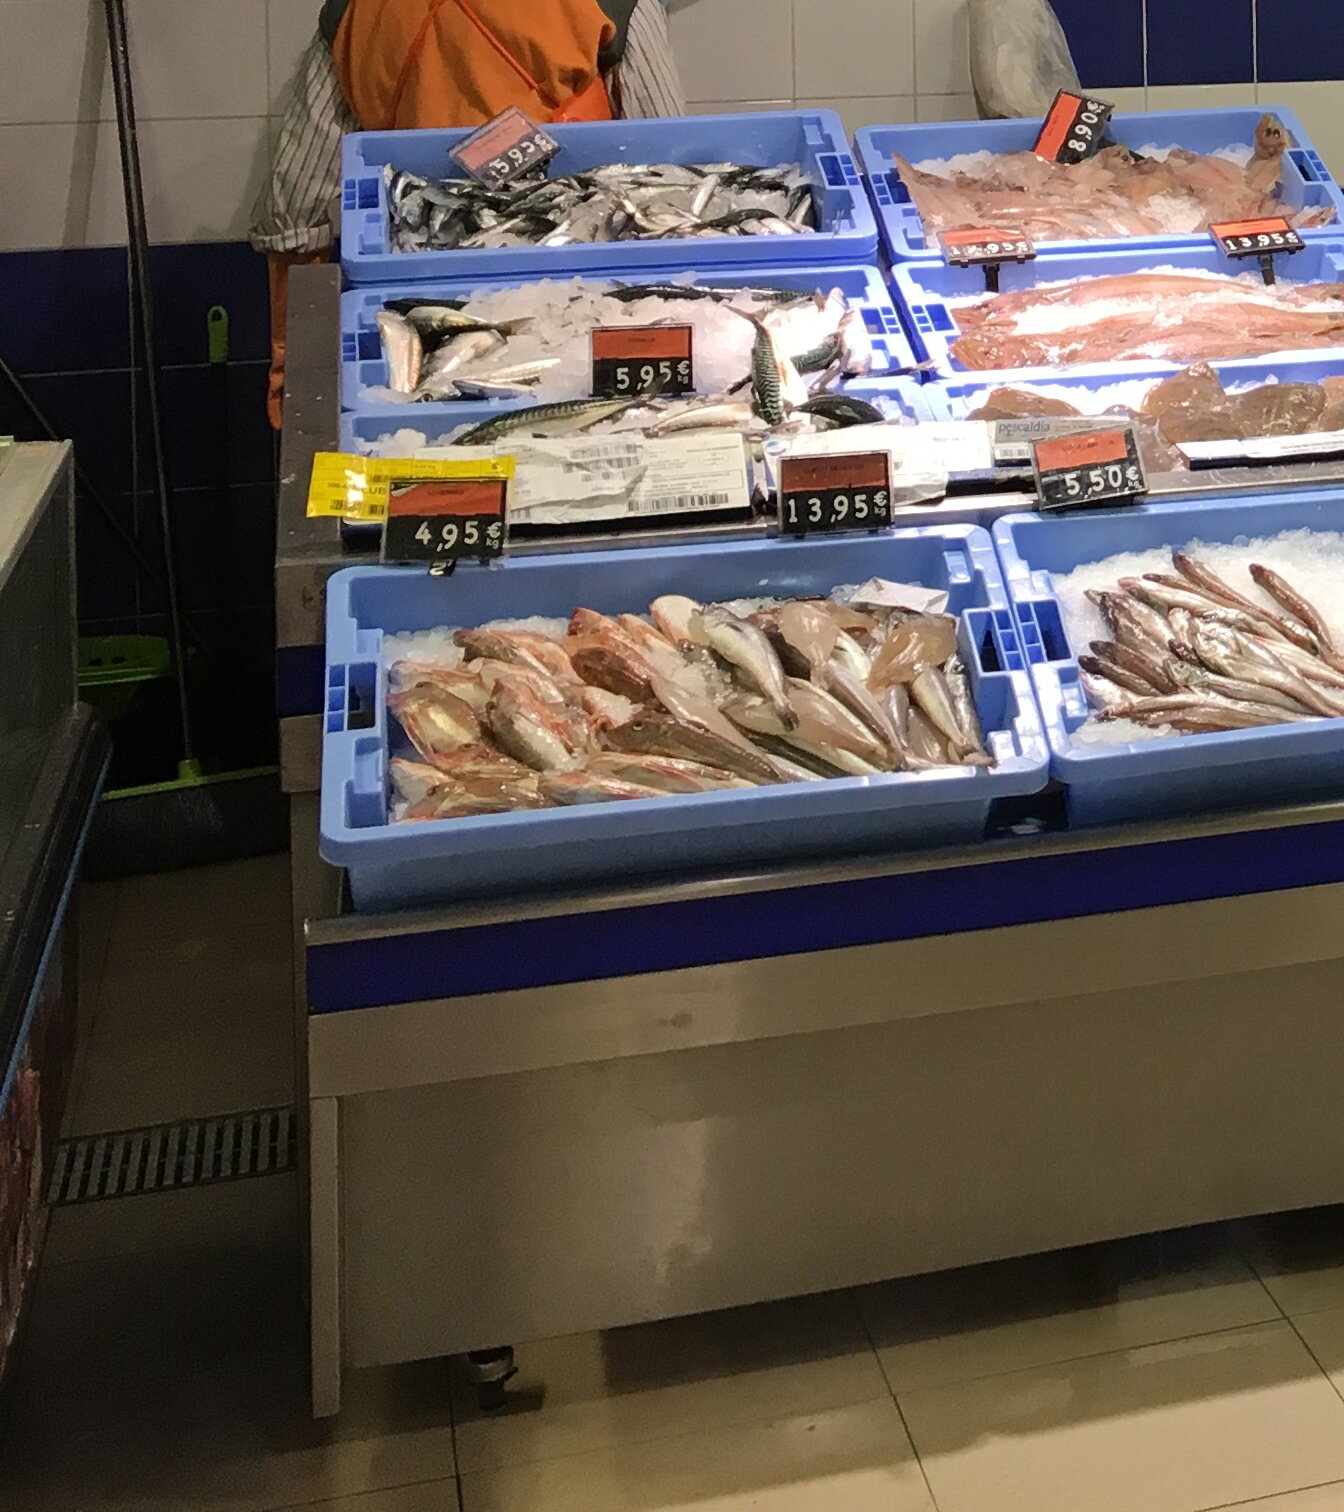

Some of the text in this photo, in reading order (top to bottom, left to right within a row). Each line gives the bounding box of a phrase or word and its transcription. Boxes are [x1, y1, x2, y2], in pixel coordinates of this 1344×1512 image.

[1068, 112, 1098, 152] 8,90
[1226, 232, 1284, 250] 13,95
[616, 360, 672, 390] 5,95
[999, 419, 1050, 435] pescaldia
[1064, 465, 1123, 496] 5,50
[788, 493, 869, 524] 13,95
[414, 520, 479, 552] 4,95
